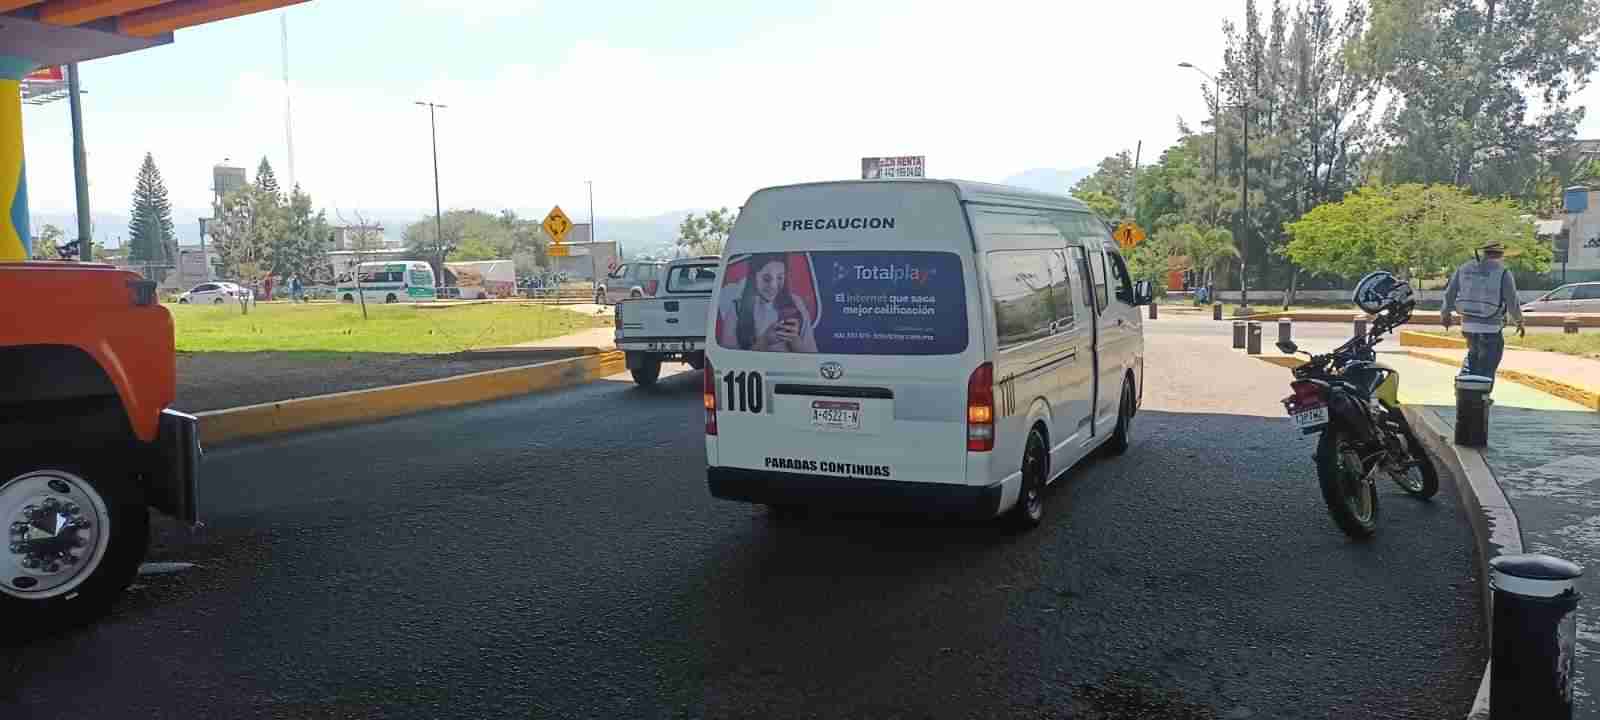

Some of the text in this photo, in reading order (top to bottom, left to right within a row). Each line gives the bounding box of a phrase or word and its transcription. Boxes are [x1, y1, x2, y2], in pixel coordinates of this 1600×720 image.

[781, 217, 895, 231] PRECAUCION
[835, 294, 845, 303] El
[889, 295, 909, 305] que
[843, 303, 936, 317] mejor calificación
[723, 370, 763, 413] 110
[764, 456, 891, 477] PARADAS CONTINUAS
